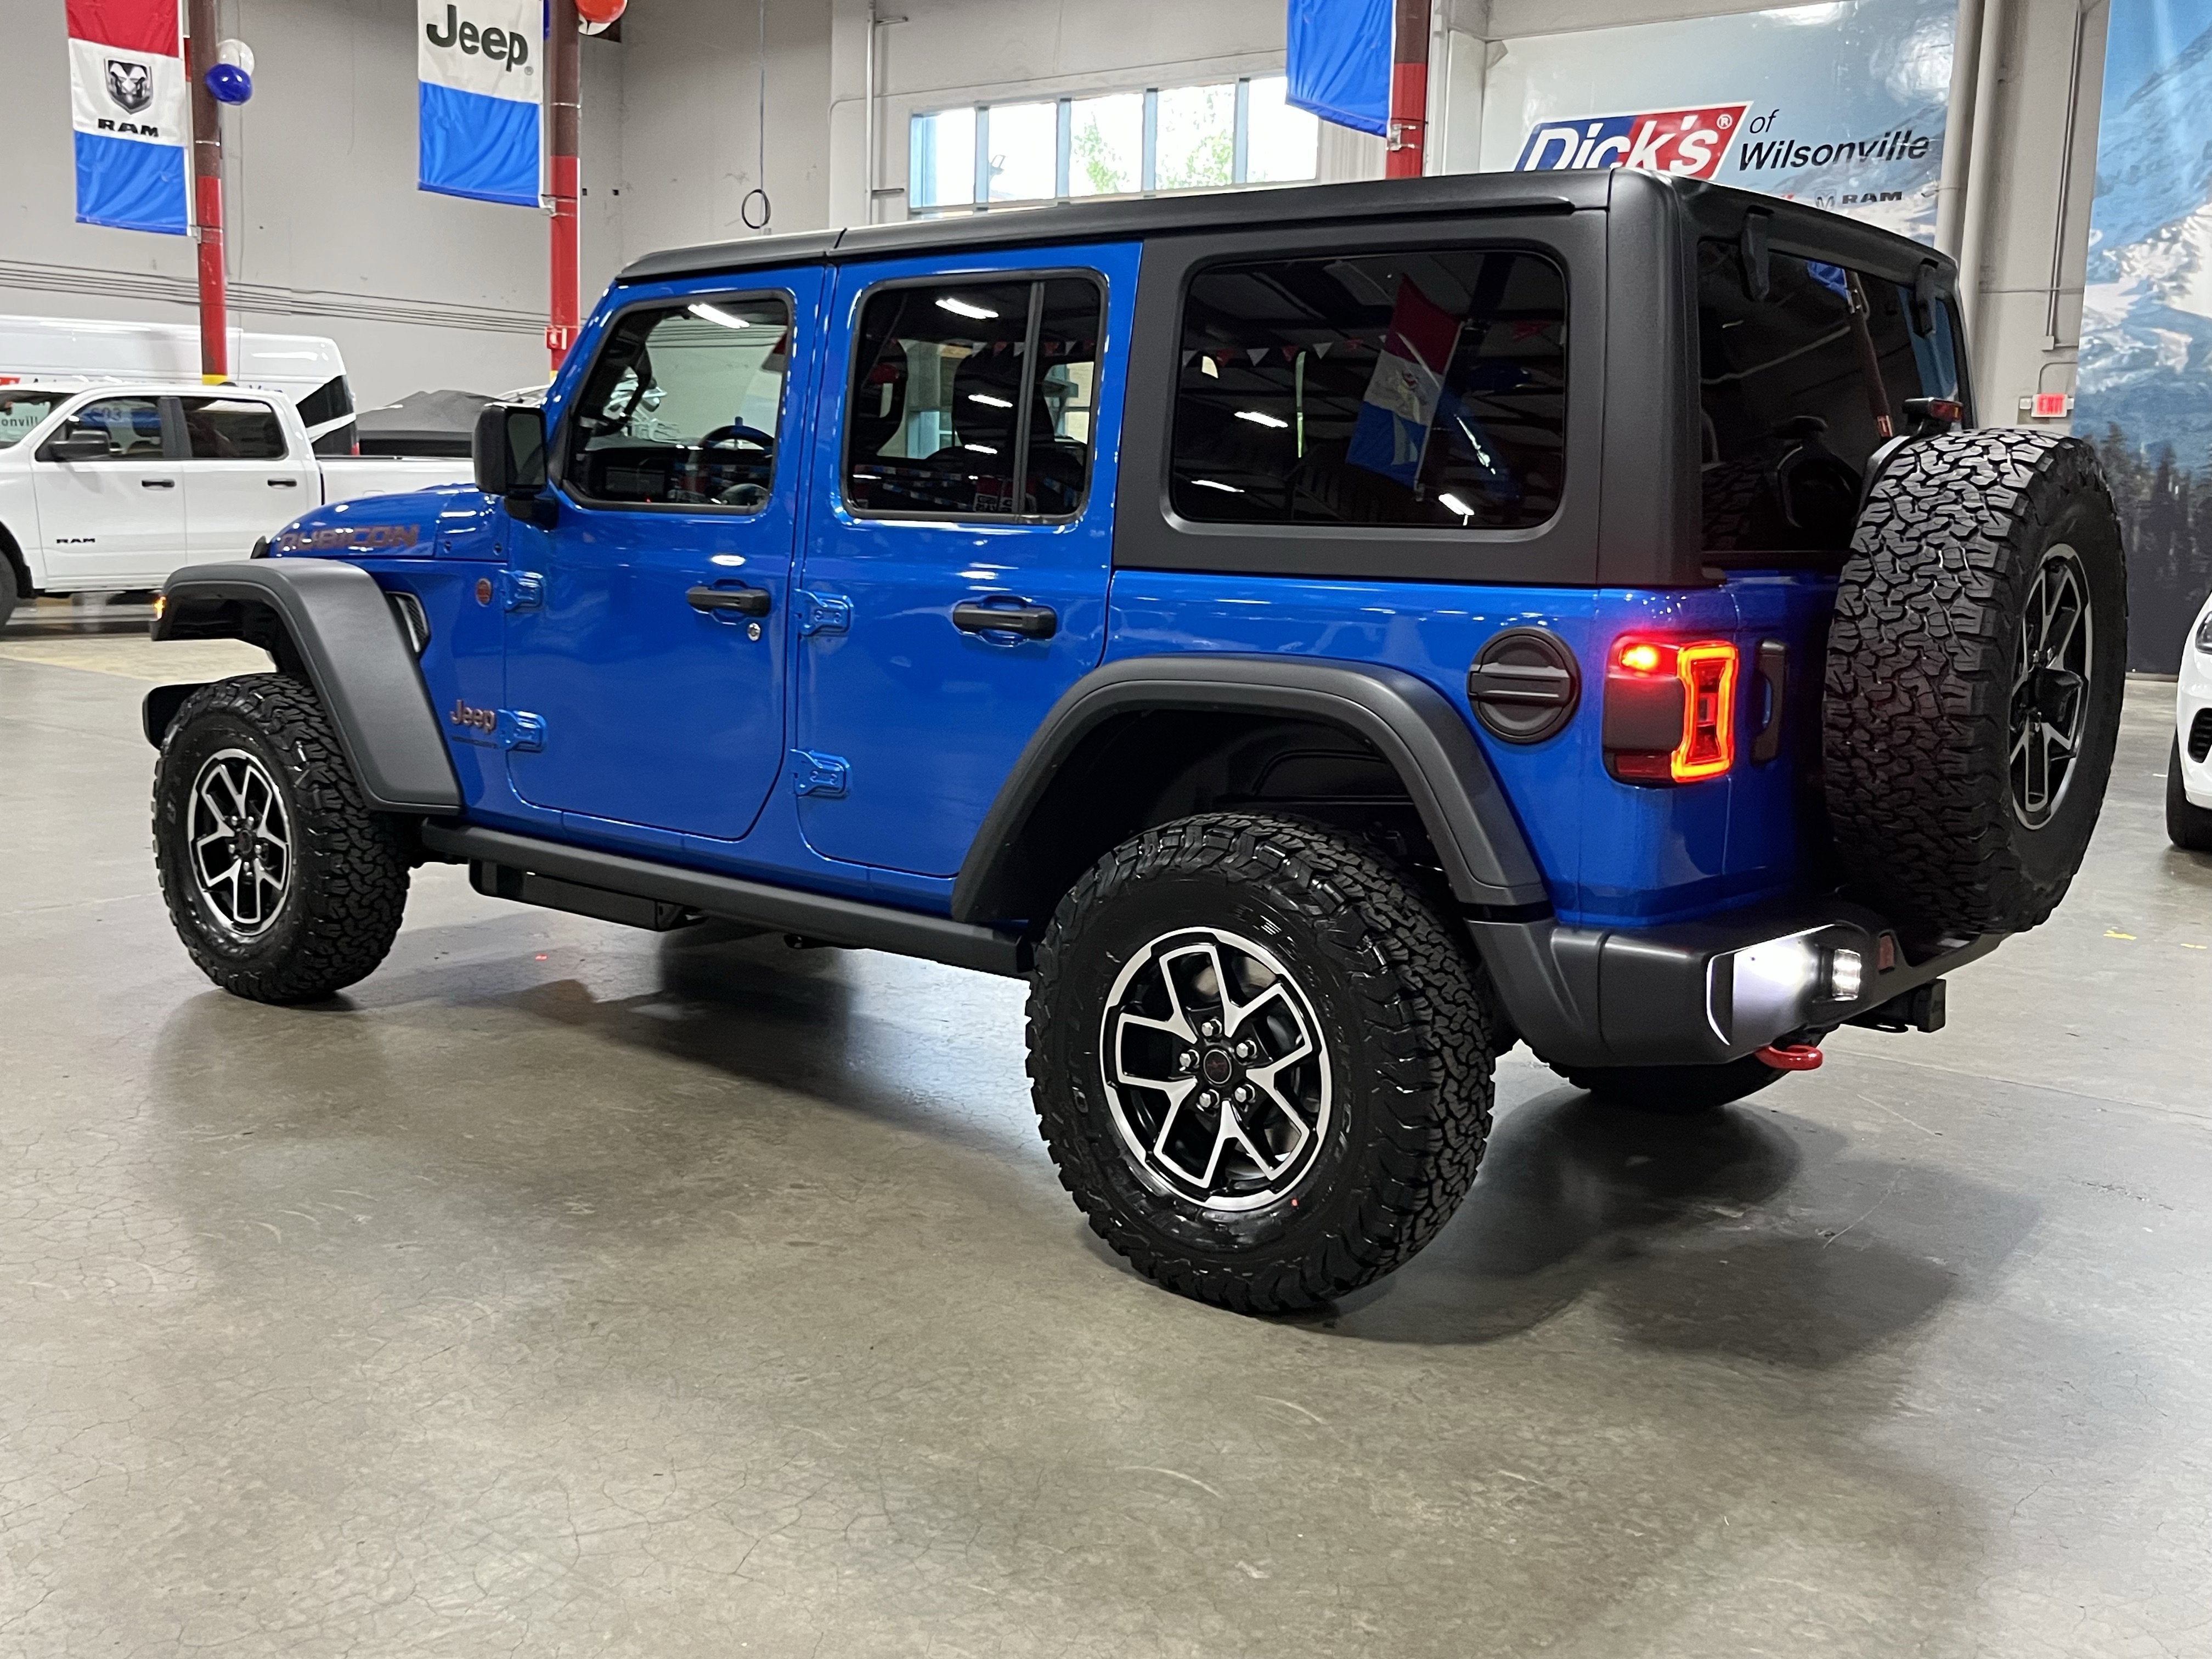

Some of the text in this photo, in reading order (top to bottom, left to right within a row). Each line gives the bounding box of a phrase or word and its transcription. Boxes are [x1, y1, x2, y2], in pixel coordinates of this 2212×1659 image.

[426, 4, 528, 72] Jeep
[98, 119, 159, 137] RAM
[1750, 109, 1779, 133] of
[1739, 130, 1929, 171] Wilsonville
[1842, 191, 1903, 204] RAM
[2038, 395, 2064, 415] EXIT
[279, 524, 420, 551] RUBICON
[450, 699, 496, 734] Jeep
